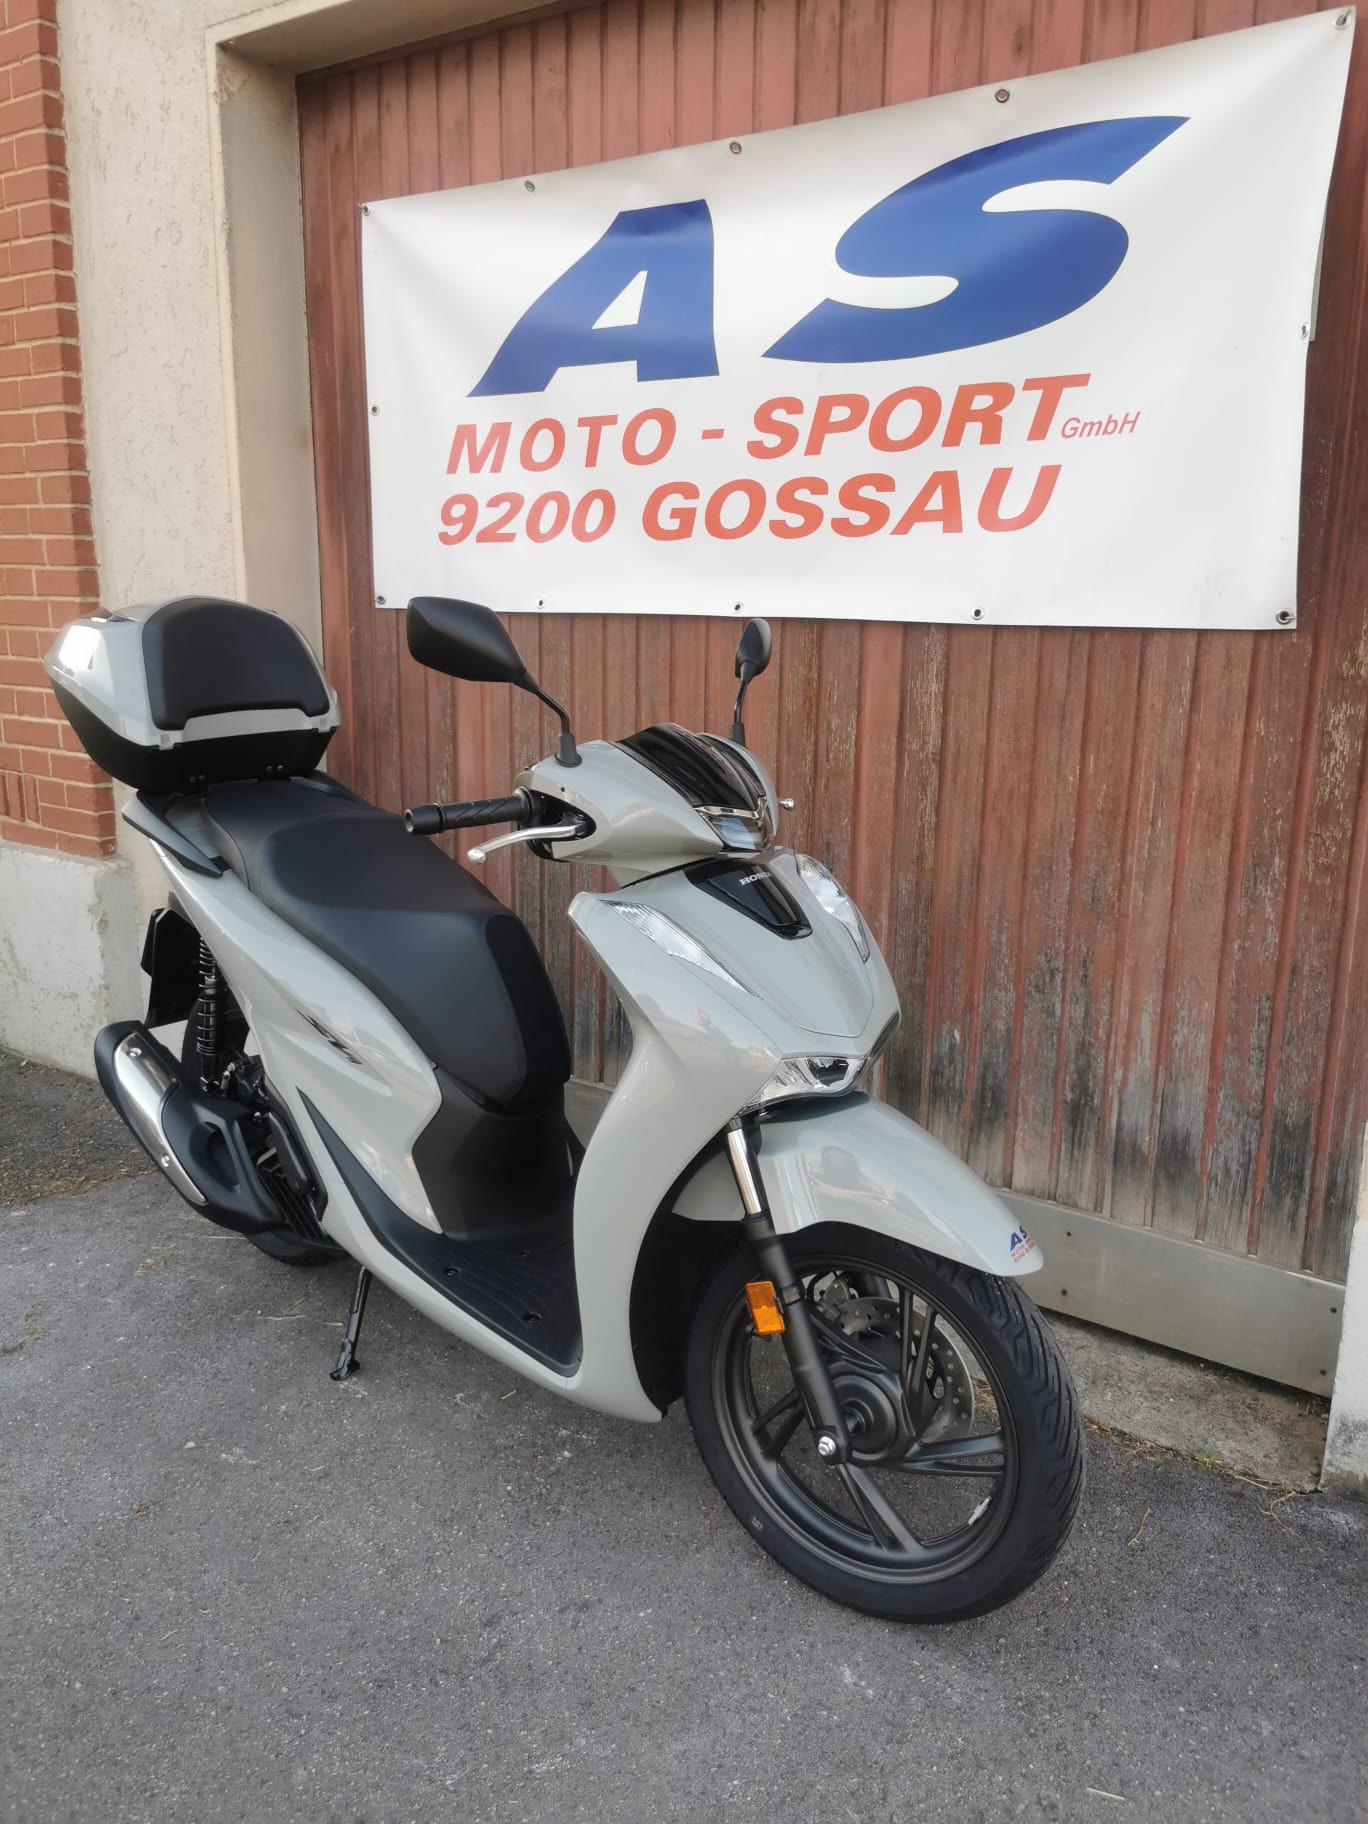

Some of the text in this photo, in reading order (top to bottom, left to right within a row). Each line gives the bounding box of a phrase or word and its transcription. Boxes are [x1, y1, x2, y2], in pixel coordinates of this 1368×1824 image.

[446, 406, 676, 475] MOTO
[746, 374, 1091, 460] SPORT
[1060, 411, 1141, 439] GmbH
[437, 464, 1062, 546] 9200 GOSSAU
